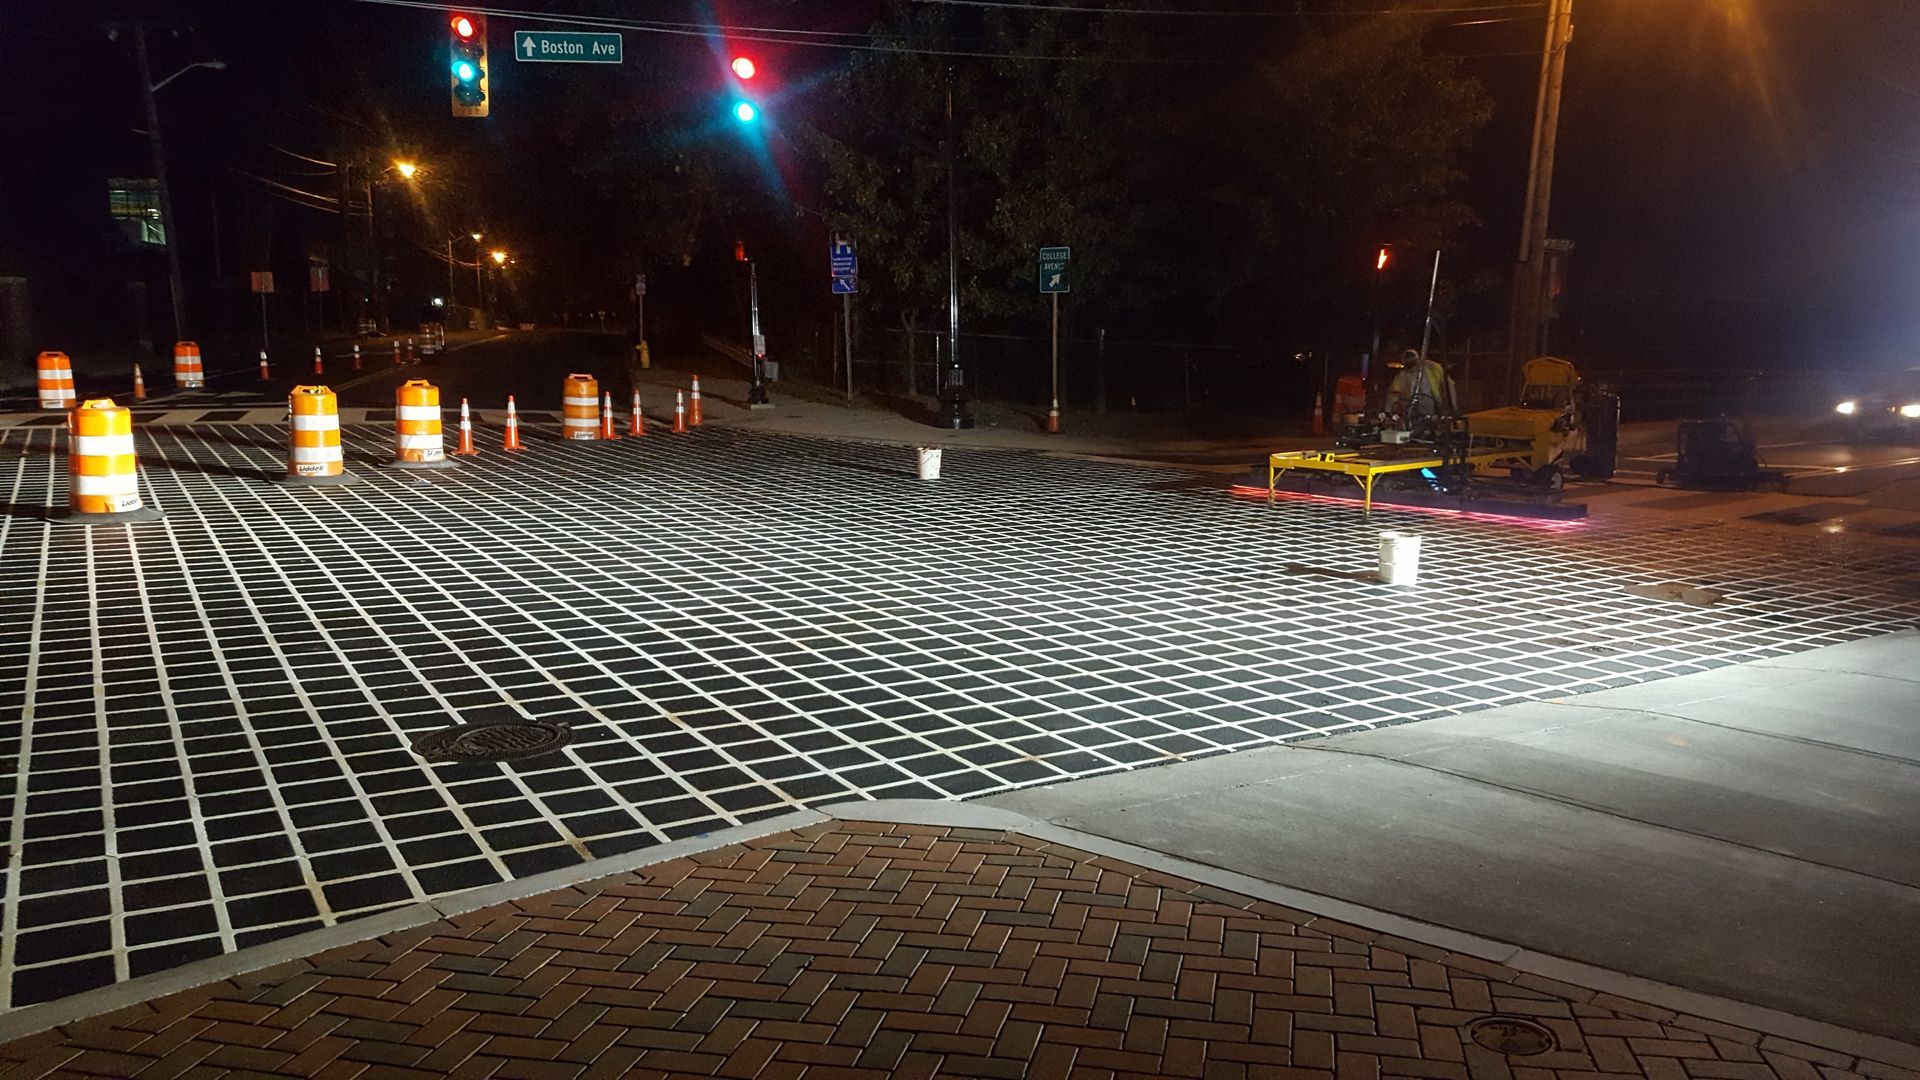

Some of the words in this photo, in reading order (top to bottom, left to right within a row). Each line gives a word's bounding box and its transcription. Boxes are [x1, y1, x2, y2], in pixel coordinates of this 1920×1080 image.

[541, 39, 584, 54] Boston
[592, 41, 615, 55] Ave
[1042, 251, 1068, 261] COLLEGE
